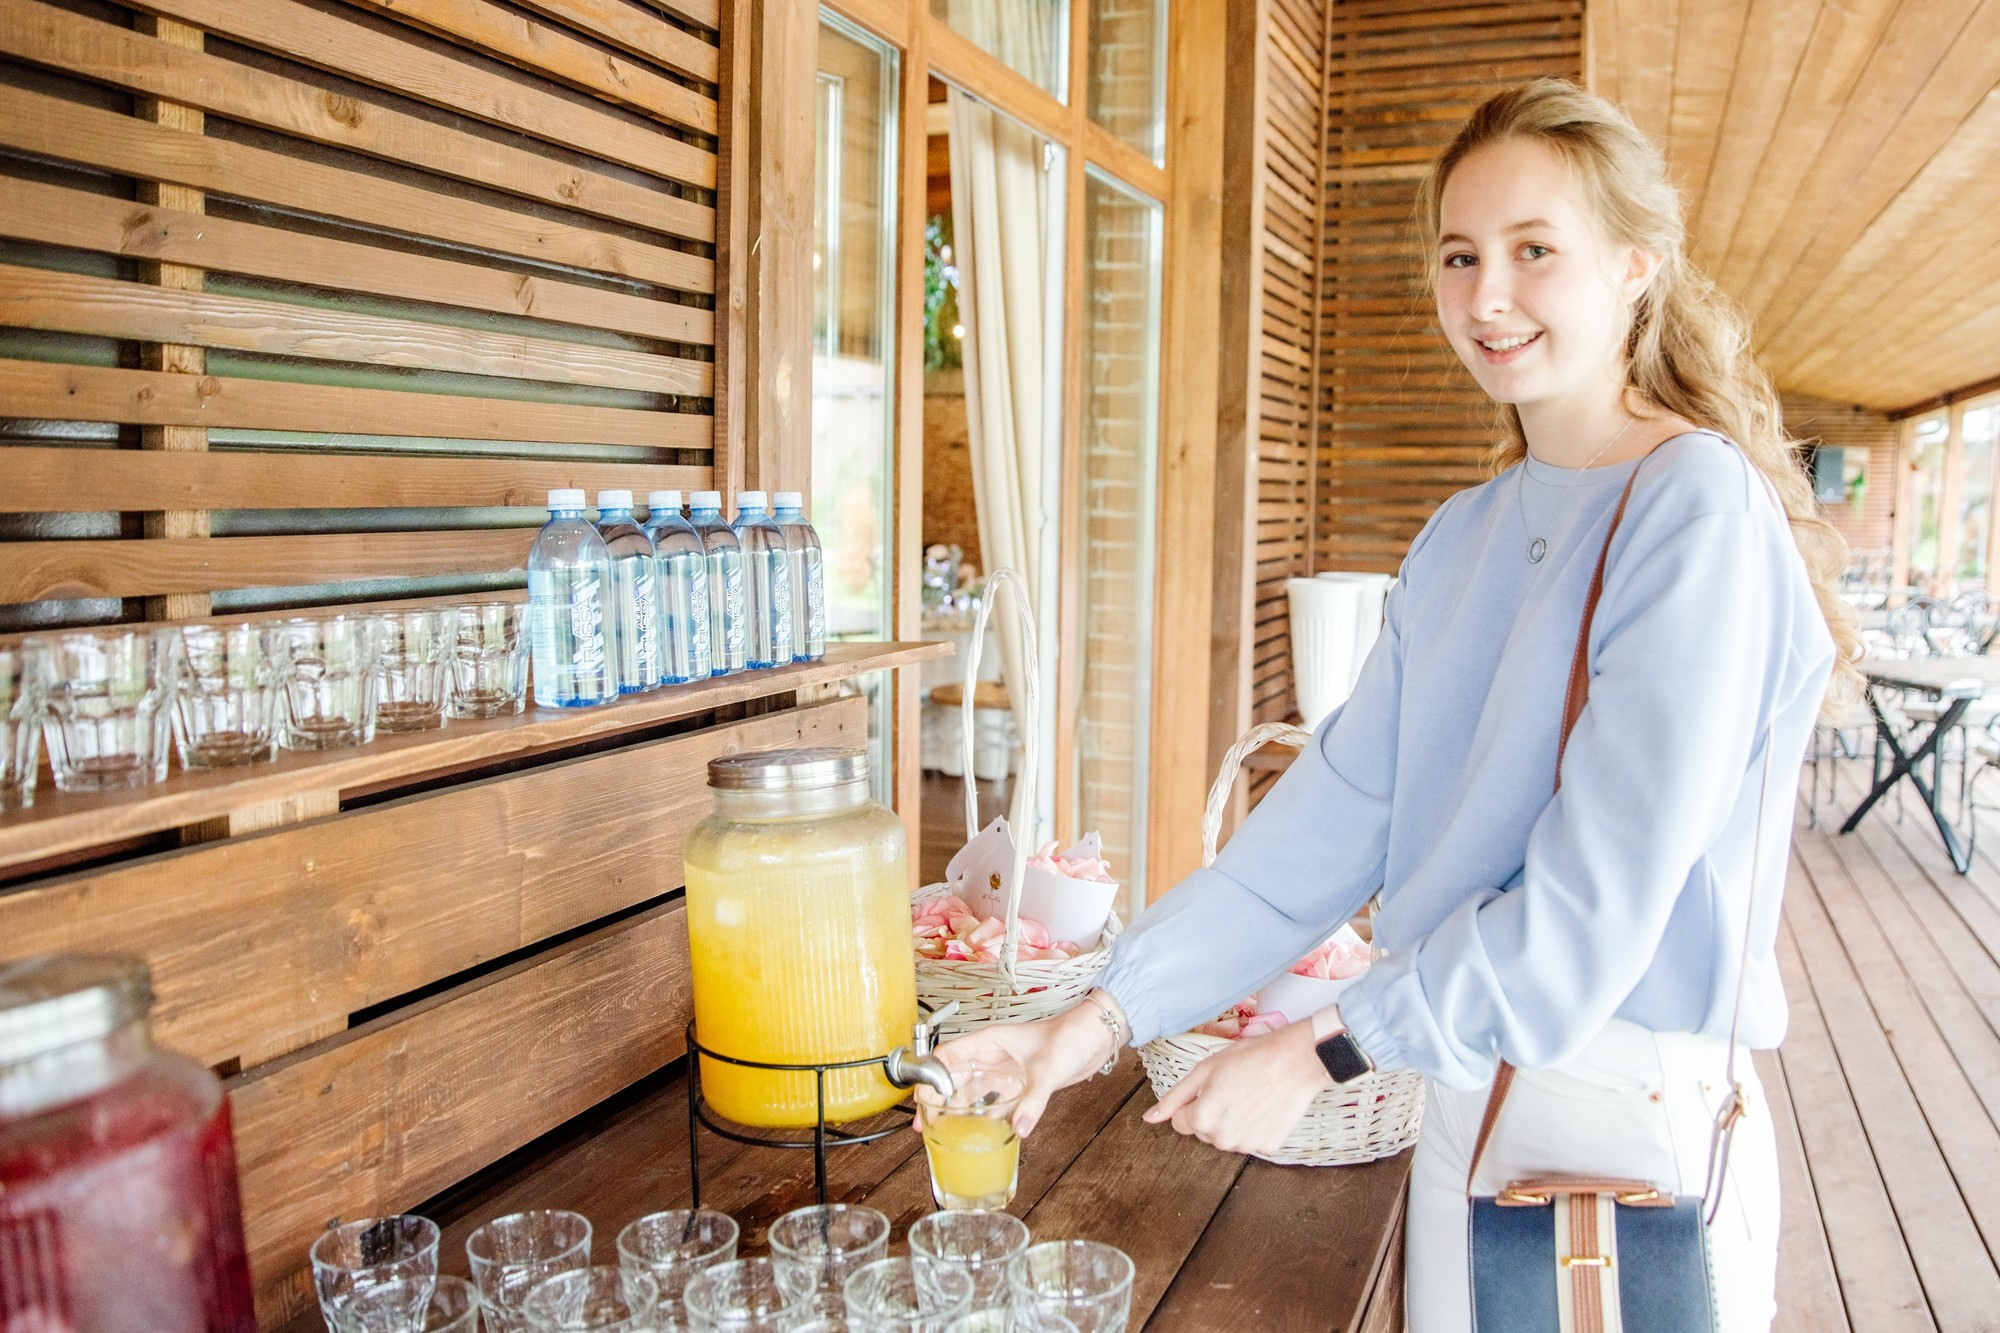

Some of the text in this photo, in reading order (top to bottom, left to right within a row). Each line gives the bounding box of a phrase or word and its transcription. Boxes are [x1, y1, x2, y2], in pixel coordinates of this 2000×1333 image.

[572, 604, 581, 636] AQUA
[634, 597, 642, 628] AQUA
[580, 596, 595, 663] RUSSA
